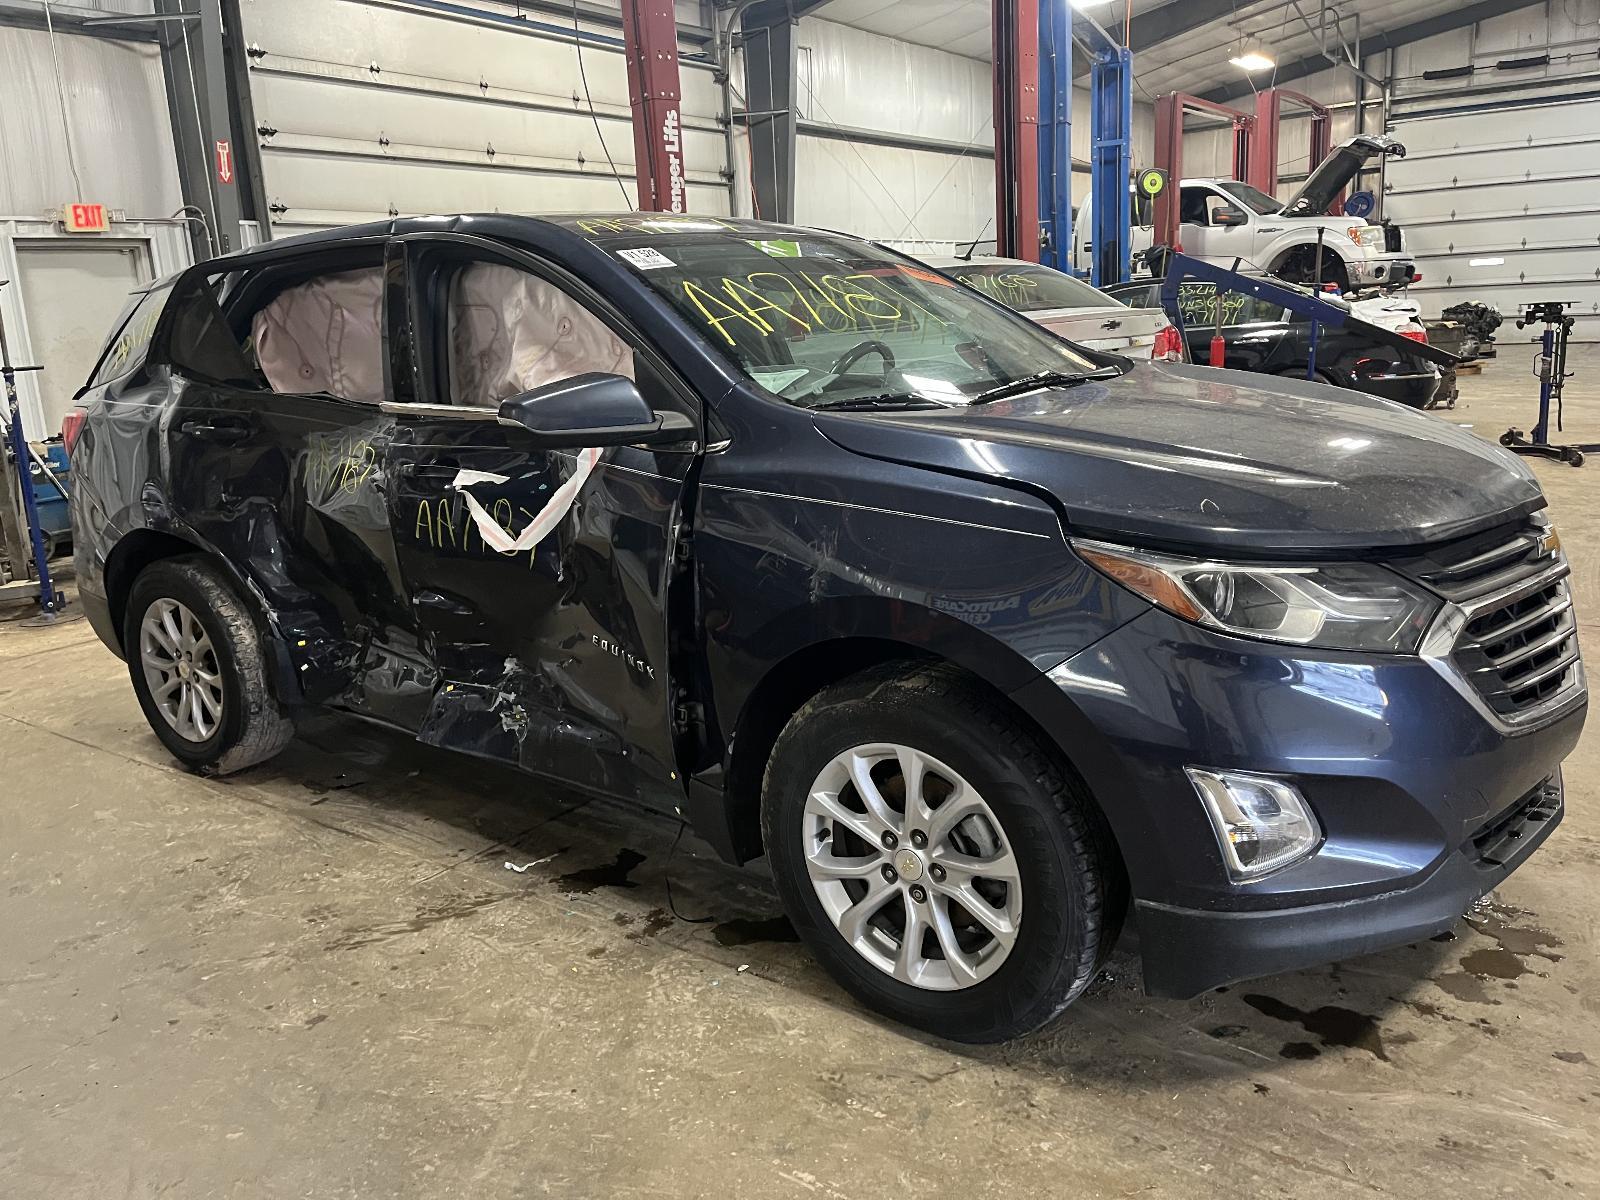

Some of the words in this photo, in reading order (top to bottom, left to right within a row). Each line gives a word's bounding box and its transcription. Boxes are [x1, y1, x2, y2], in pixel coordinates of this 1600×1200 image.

[663, 110, 679, 152] Lifts
[669, 153, 685, 213] enger
[72, 204, 104, 228] EXIT
[592, 634, 655, 680] EQUINOX
